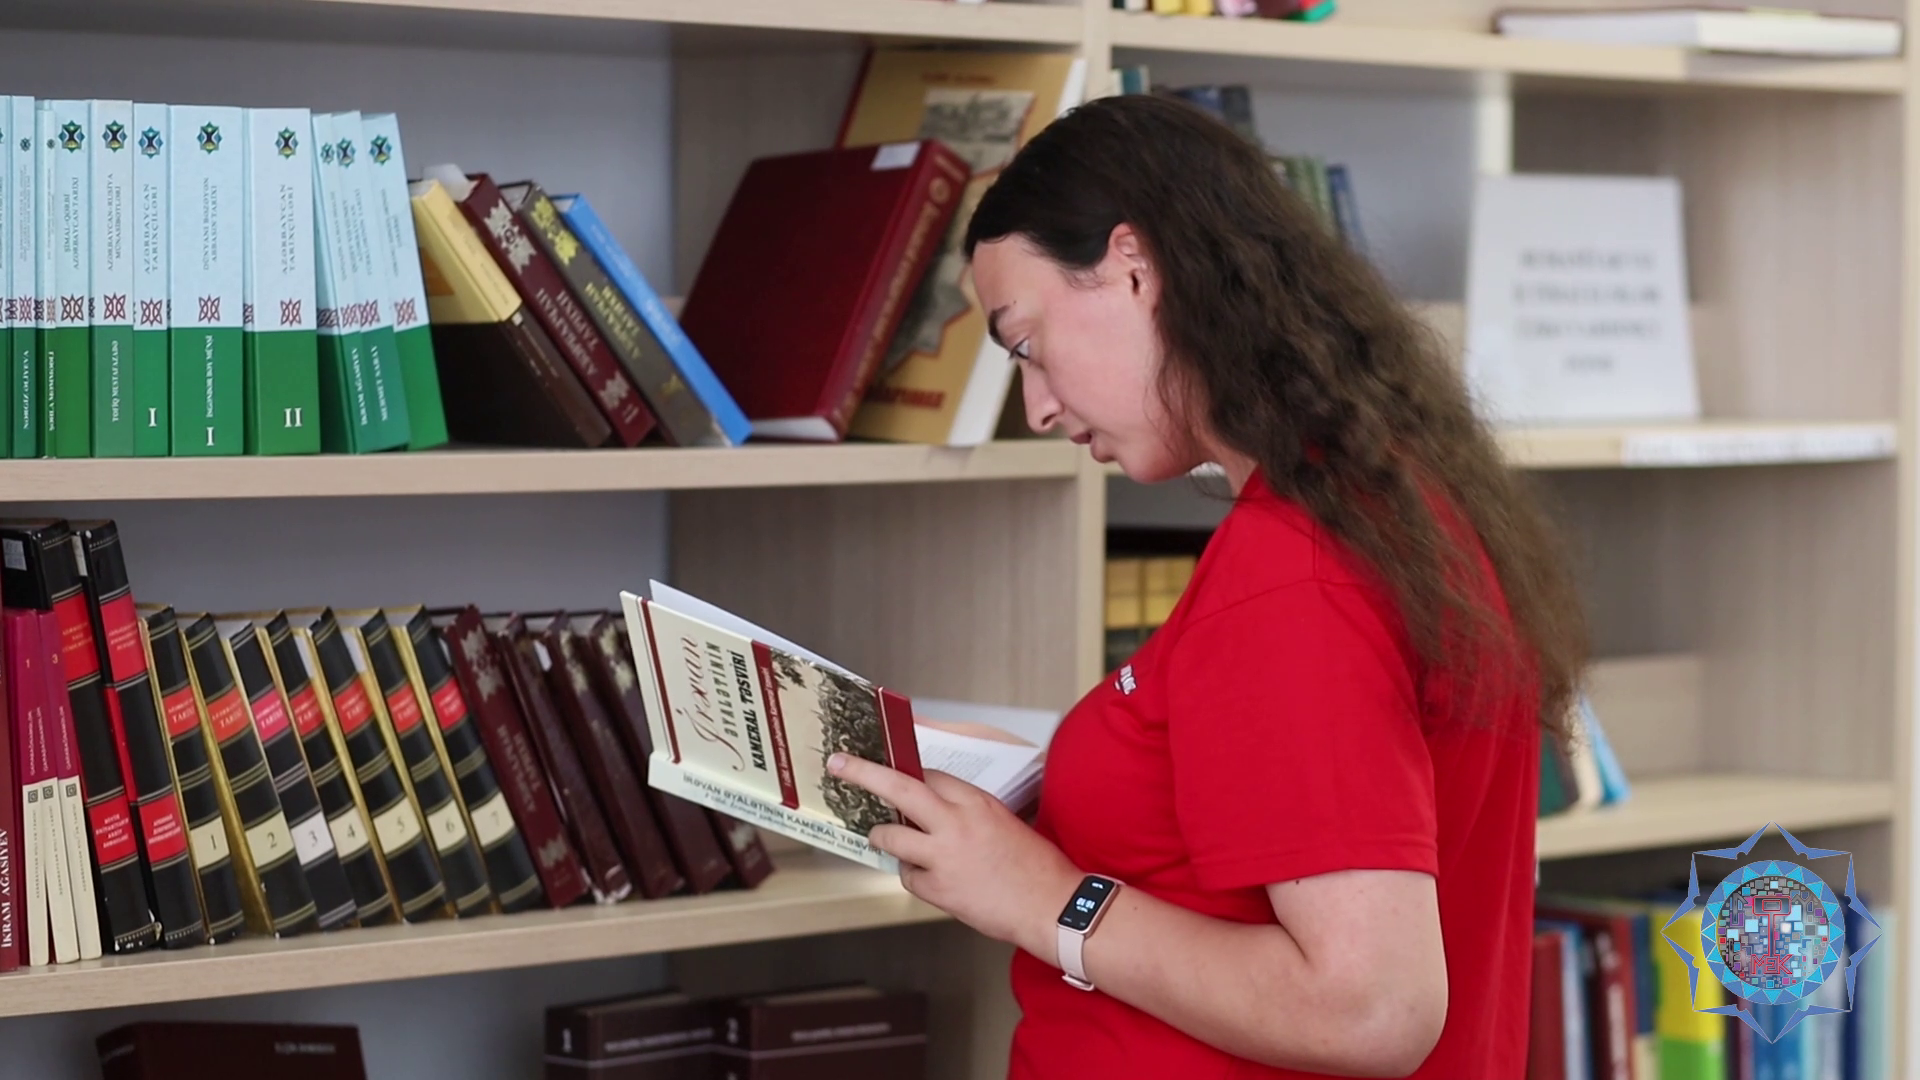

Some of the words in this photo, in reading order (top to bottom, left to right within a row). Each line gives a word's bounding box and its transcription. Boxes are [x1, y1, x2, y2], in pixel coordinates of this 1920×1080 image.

[283, 407, 302, 427] II
[26, 659, 30, 668] 1
[52, 654, 58, 664] 3
[727, 649, 755, 705] TƏSVİRİ
[703, 641, 739, 738] ƏYALƏTİNİN
[743, 708, 767, 772] KAMERAL
[723, 790, 785, 821] ƏYALƏTİNİN
[786, 813, 838, 839] KAMERAL
[346, 824, 357, 839] 4
[397, 817, 405, 833] 5
[446, 819, 455, 833] 6
[210, 834, 217, 850] 1
[267, 833, 278, 849] 2
[309, 831, 318, 847] 3
[1, 900, 12, 949] İKRAM
